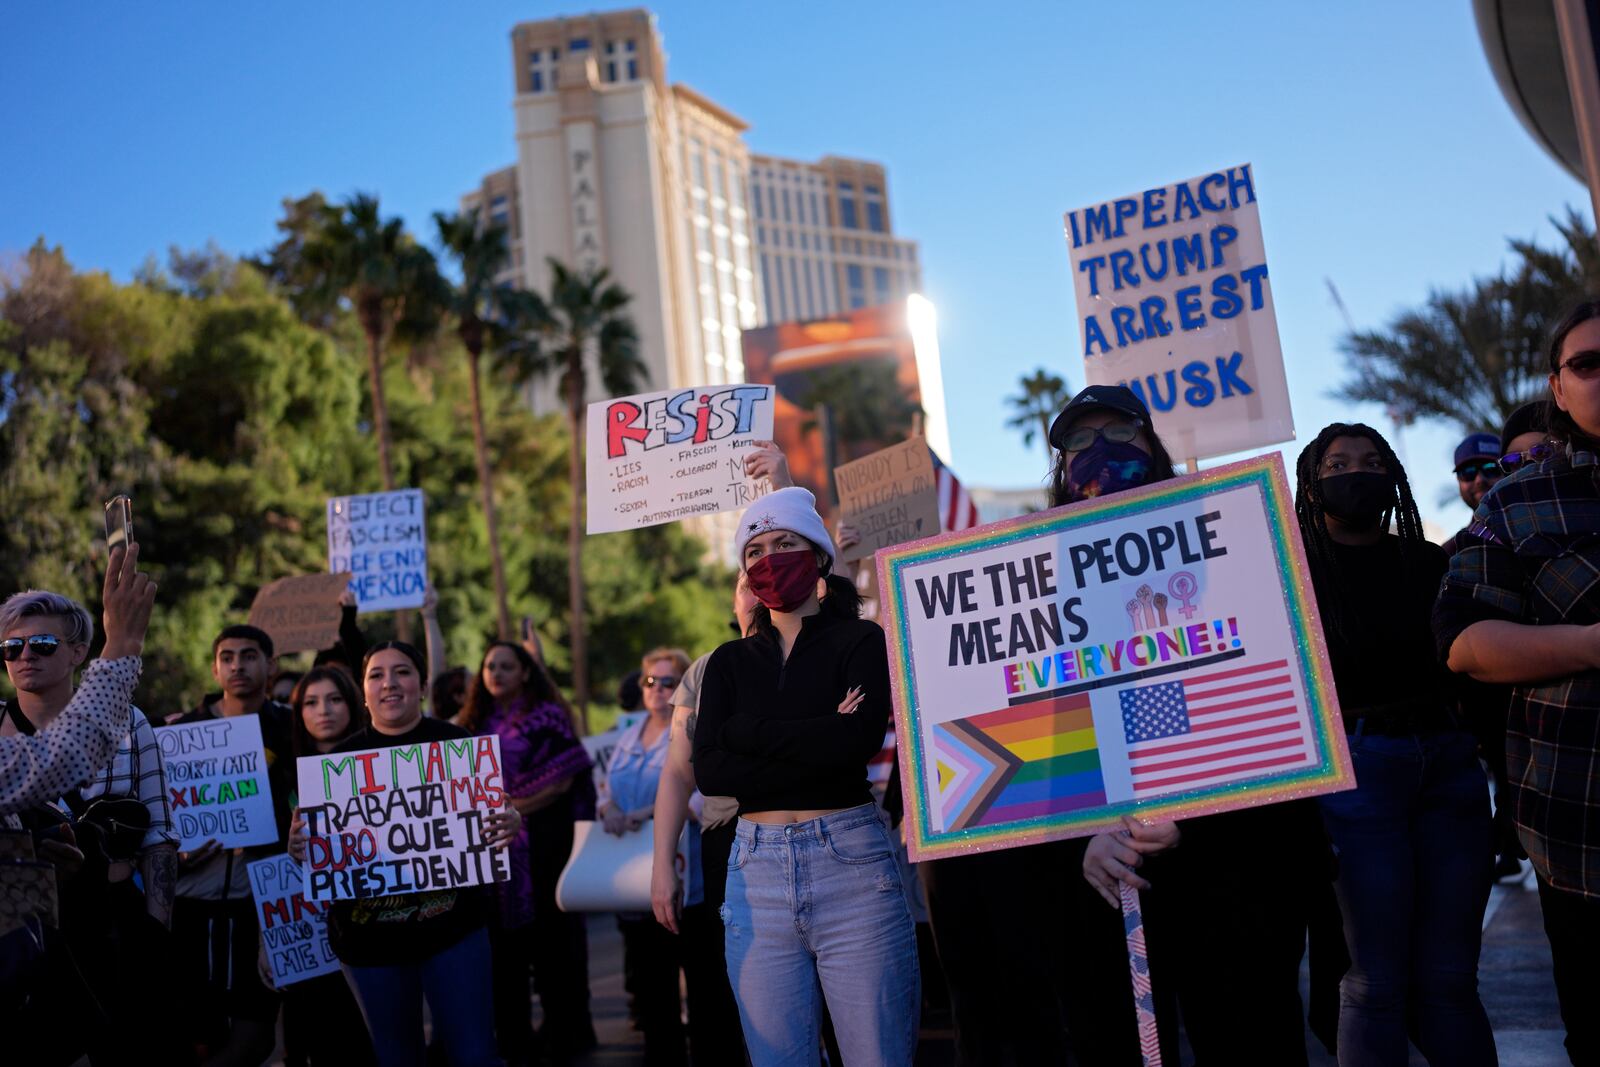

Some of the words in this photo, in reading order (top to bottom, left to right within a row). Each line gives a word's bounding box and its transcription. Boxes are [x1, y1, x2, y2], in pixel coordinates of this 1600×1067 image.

[1067, 165, 1257, 249] IMPEACH
[1079, 224, 1239, 297] TRUMP
[1084, 263, 1268, 357] ARREST
[678, 445, 717, 462] FASCISM
[732, 439, 752, 449] KLEPT
[615, 461, 642, 478] LIES
[616, 475, 649, 493] RACISM
[837, 453, 893, 496] NOBODY
[903, 444, 922, 471] IS
[331, 494, 419, 524] REJECT
[676, 487, 713, 502] TREASON
[848, 482, 906, 516] ILLEGAL
[912, 475, 929, 495] ON
[860, 503, 908, 533] STOLEN
[332, 523, 422, 550] FASCISM
[332, 548, 425, 575] DEFEND
[915, 569, 978, 620] WE
[983, 551, 1058, 607] THE
[1069, 510, 1228, 589] PEOPLE
[347, 571, 425, 603] MERICA
[948, 597, 1089, 667] MEANS
[1003, 617, 1242, 694] EVERYONE!!
[156, 721, 232, 758] ONT
[165, 757, 218, 783] PORT
[222, 751, 258, 776] MY
[321, 752, 386, 800] MI
[390, 736, 500, 789] MAMA
[169, 777, 259, 811] XICAN
[300, 783, 448, 836] TRABAJA
[450, 773, 504, 812] MAS
[179, 808, 250, 839] DDIE
[308, 828, 377, 870] DURO
[388, 817, 454, 855] QUE
[310, 847, 508, 900] PRESIDENTE
[272, 942, 319, 978] ME
